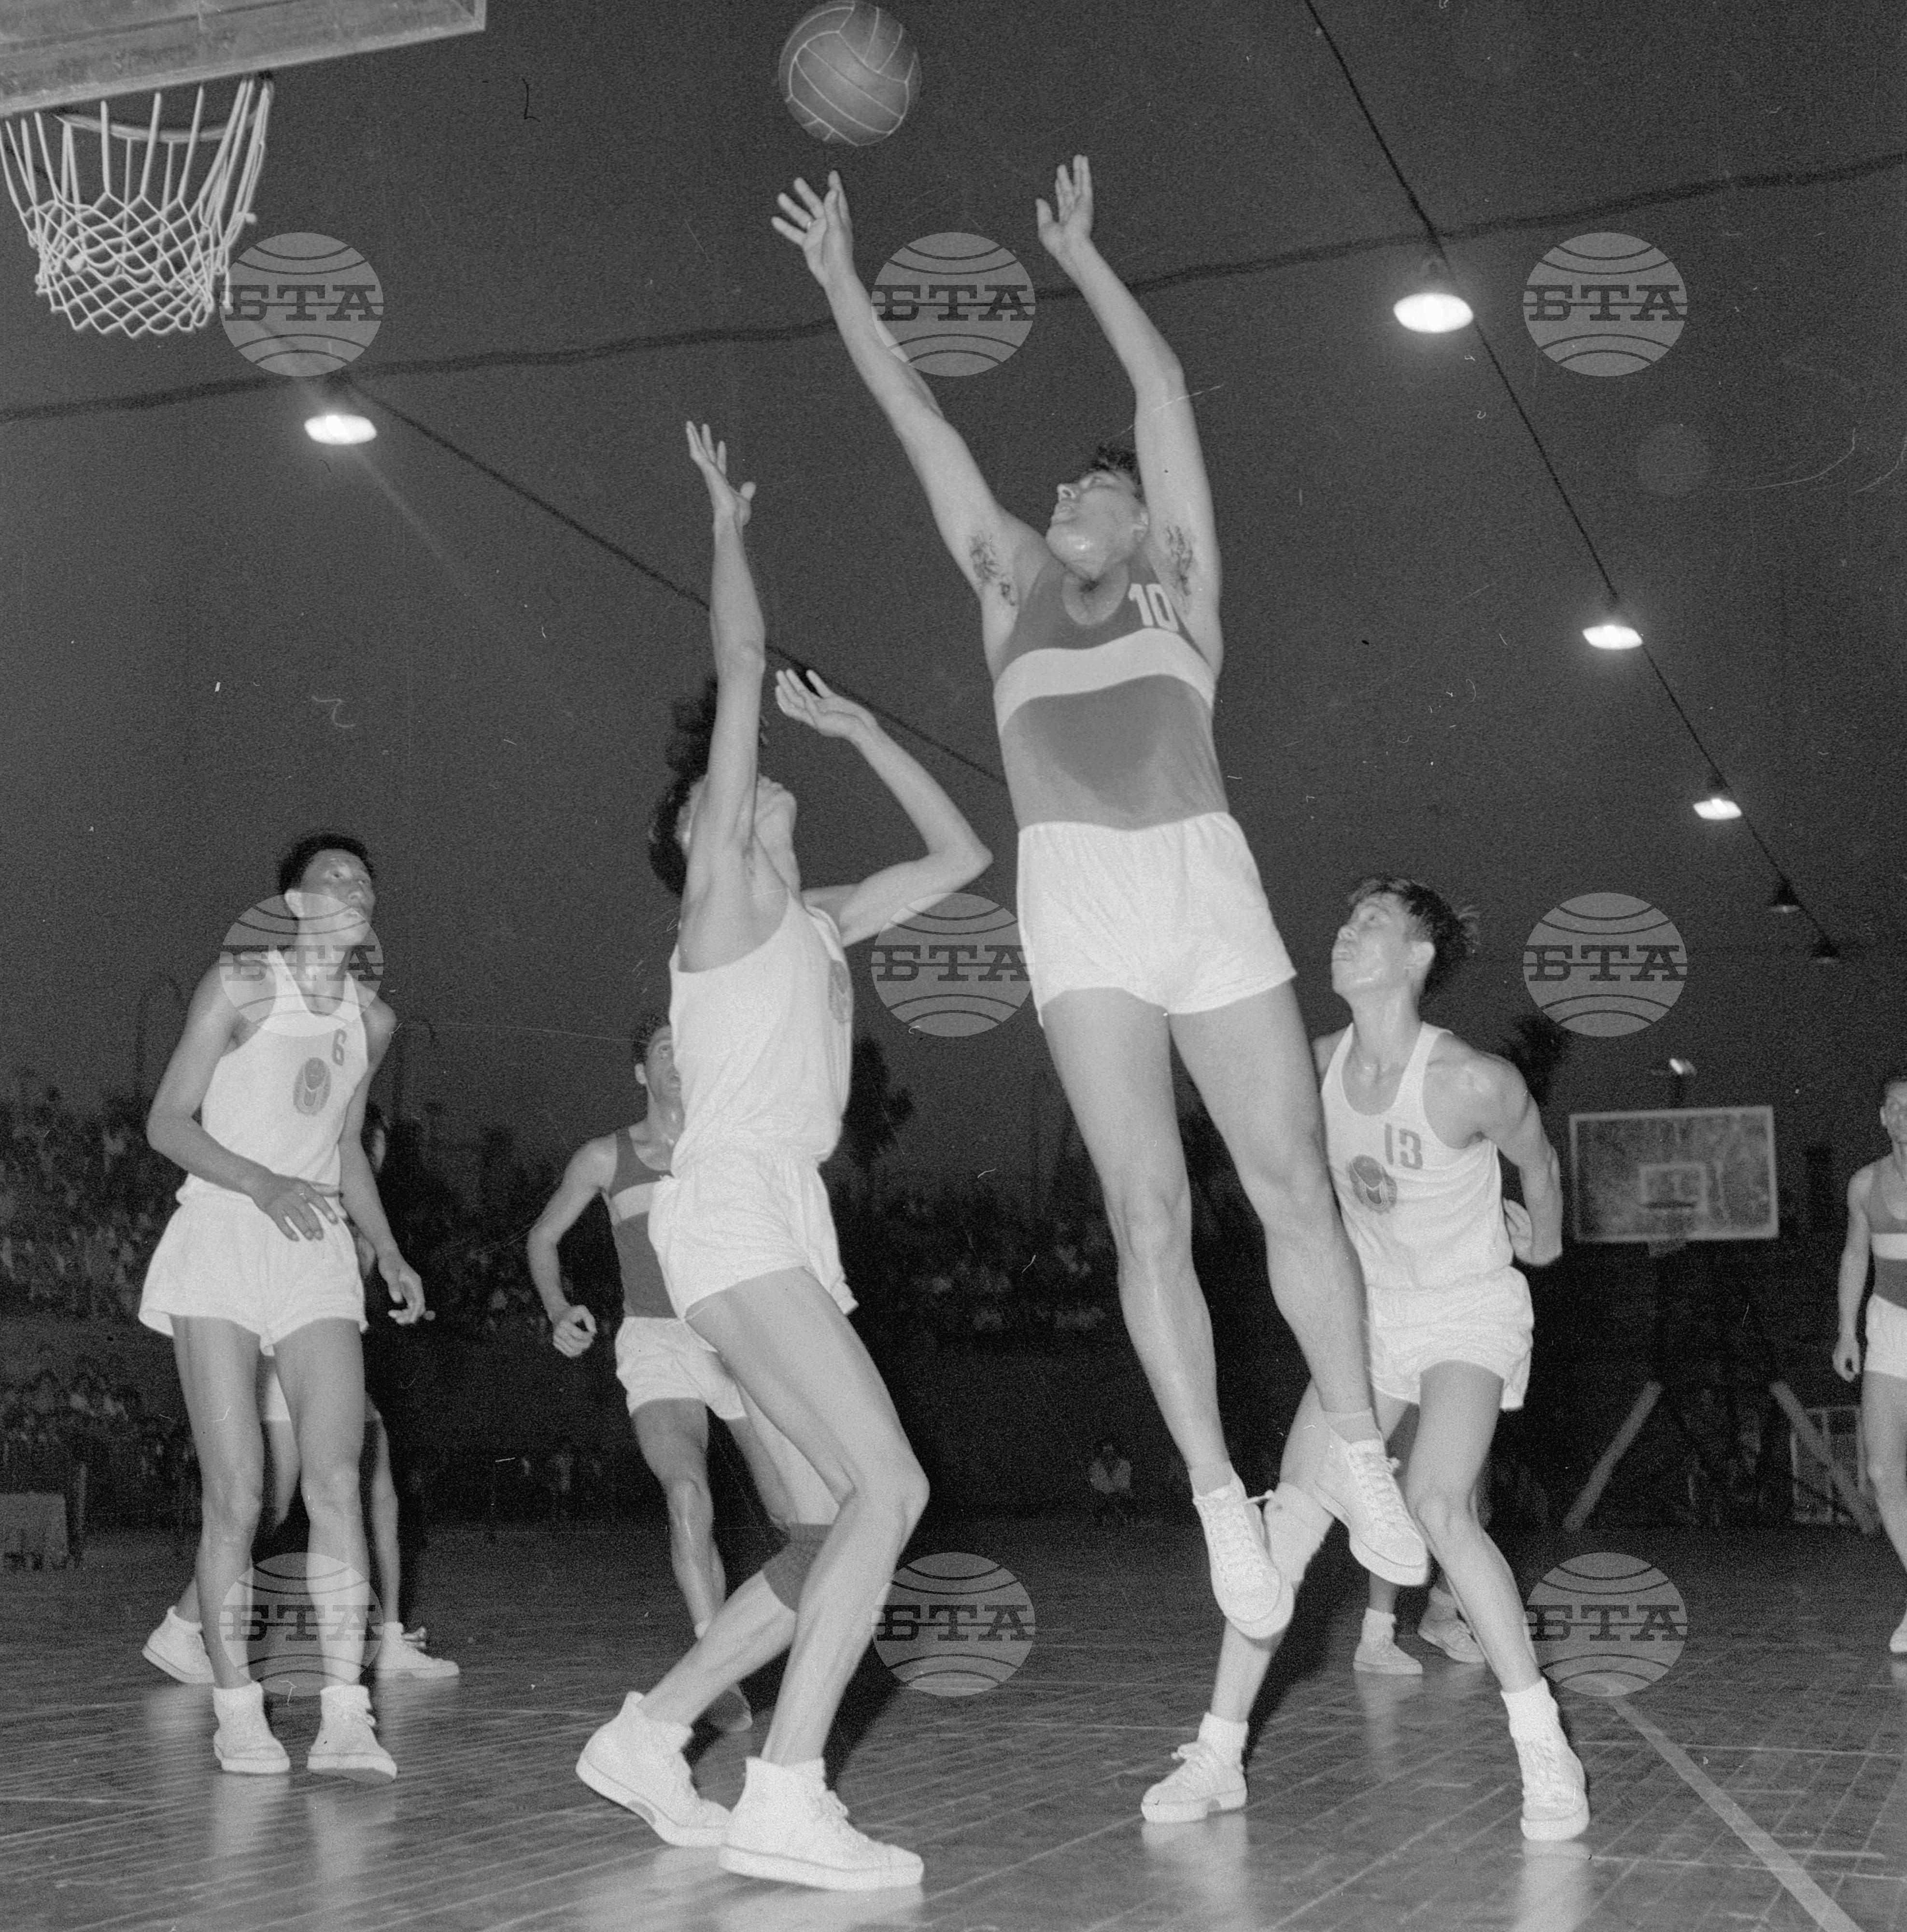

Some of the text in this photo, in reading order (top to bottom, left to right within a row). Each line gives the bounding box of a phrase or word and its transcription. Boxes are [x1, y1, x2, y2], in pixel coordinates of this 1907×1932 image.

[1129, 583, 1178, 631] 10
[332, 1029, 347, 1066] 6
[1384, 1123, 1423, 1169] 13
